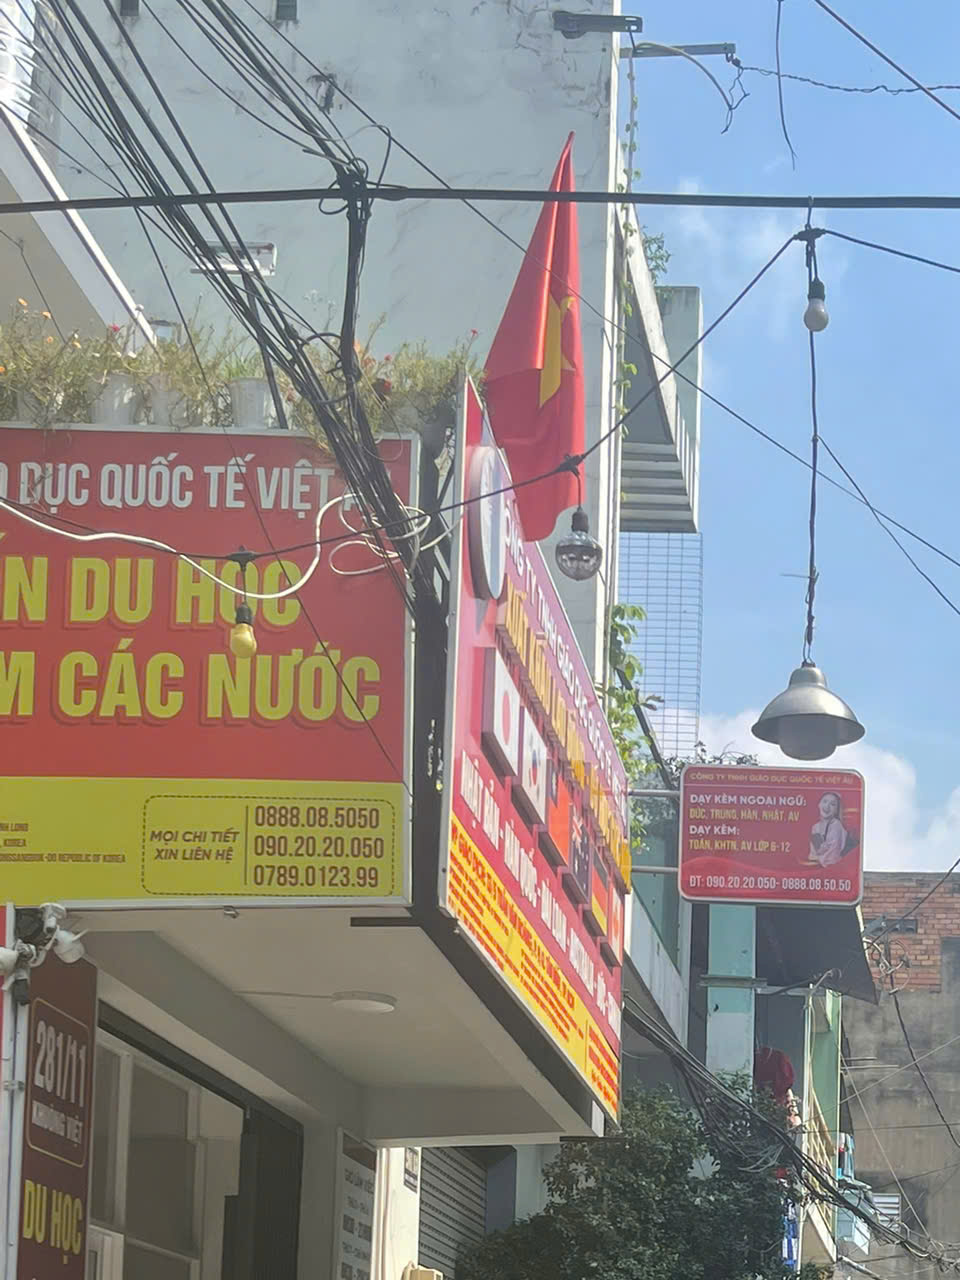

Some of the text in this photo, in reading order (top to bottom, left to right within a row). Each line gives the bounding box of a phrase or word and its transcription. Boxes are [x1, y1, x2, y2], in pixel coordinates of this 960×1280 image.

[20, 462, 90, 514] DỤC
[100, 453, 194, 508] QUỐC
[204, 453, 254, 509] TẾ
[257, 459, 335, 518] VIỆT
[0, 555, 47, 623] N
[69, 557, 154, 624] DU
[58, 639, 185, 717] CÁC
[206, 643, 381, 723] NƯỚC
[714, 792, 737, 804] KÈM
[740, 795, 776, 807] NGOẠI
[255, 805, 380, 829] 0888.08.5050
[150, 827, 240, 846] MỌI CHI TIẾT
[254, 835, 384, 858] 090.20.20.050
[154, 847, 234, 864] XIN LIÊN HỆ
[253, 864, 378, 888] 0789.0123.99
[34, 1020, 87, 1108] 281/11
[23, 1179, 83, 1264] DU HỌC
